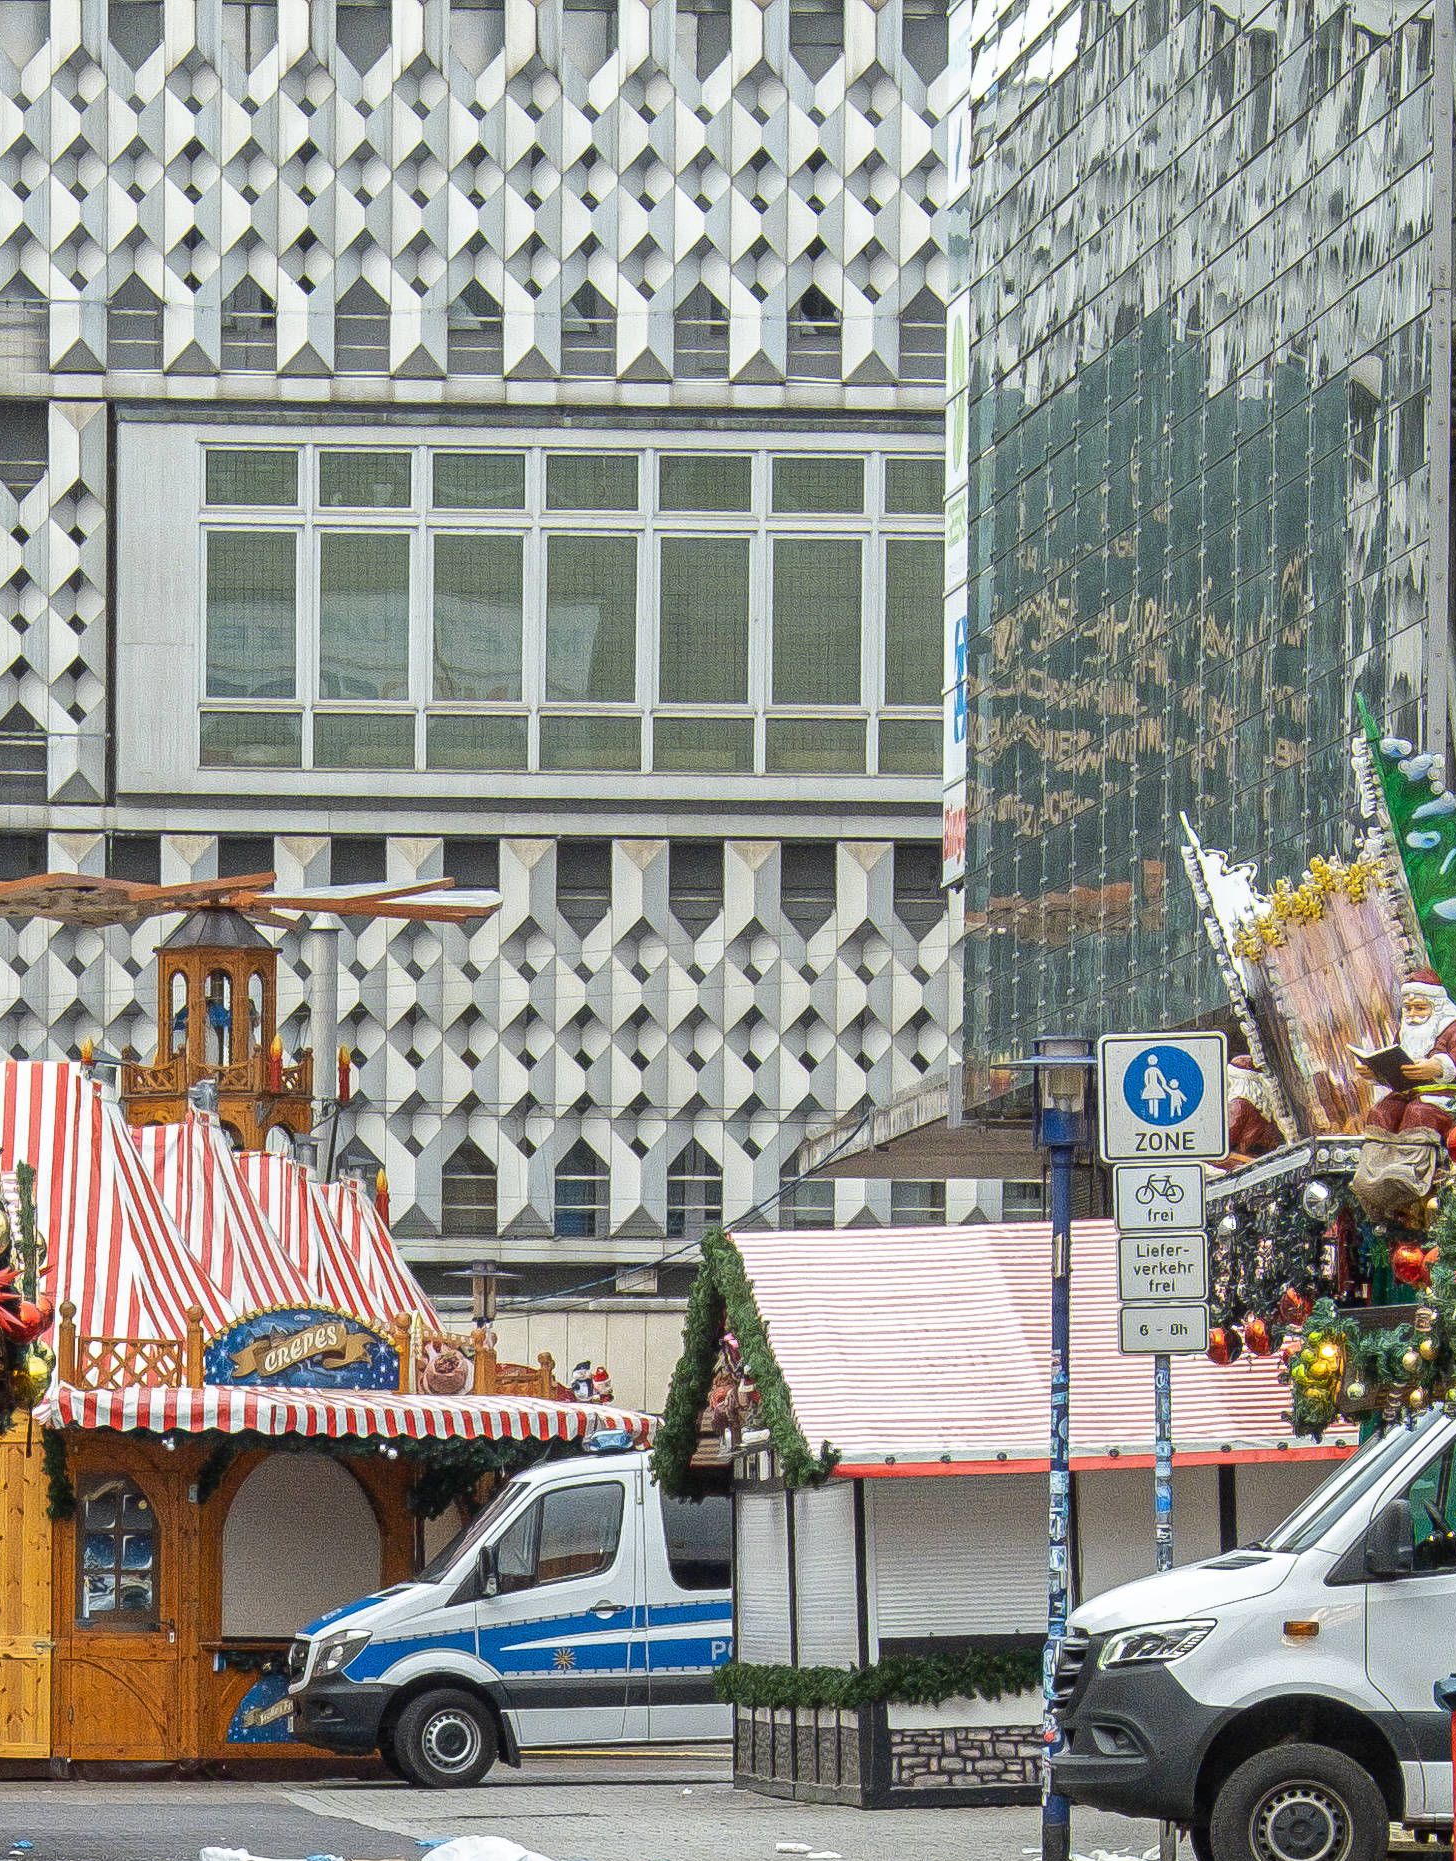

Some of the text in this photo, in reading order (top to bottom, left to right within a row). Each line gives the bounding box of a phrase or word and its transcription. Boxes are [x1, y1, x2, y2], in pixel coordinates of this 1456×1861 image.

[1136, 1131, 1196, 1153] ZONE
[1147, 1208, 1174, 1223] frei
[1136, 1244, 1190, 1259] Liefer-
[1133, 1262, 1194, 1277] verkehr
[1149, 1279, 1176, 1294] frei
